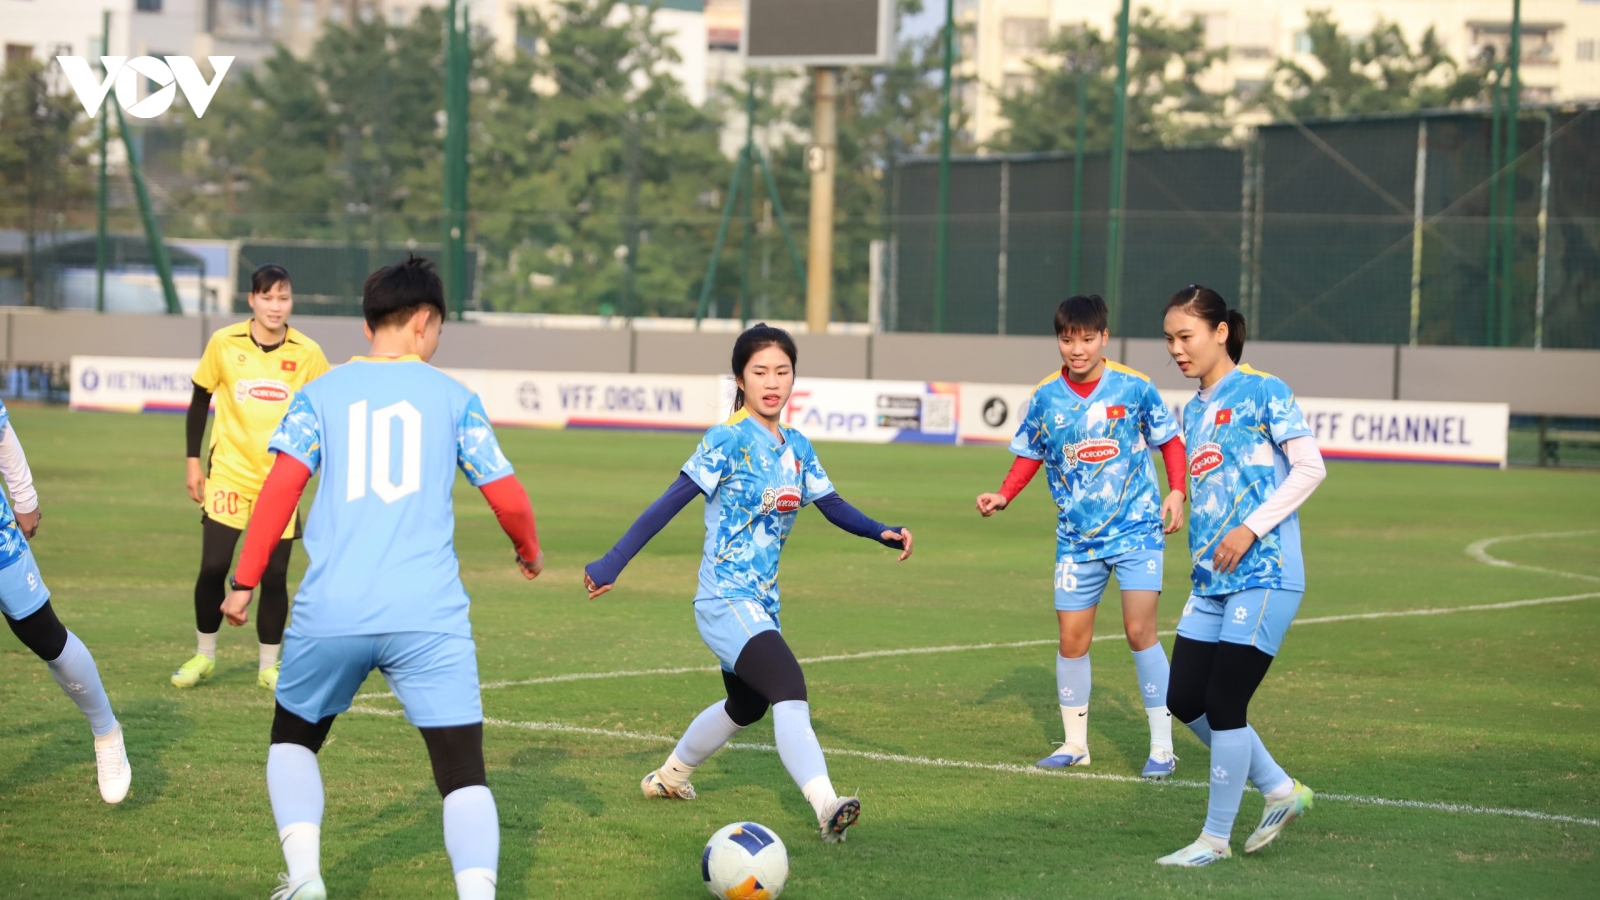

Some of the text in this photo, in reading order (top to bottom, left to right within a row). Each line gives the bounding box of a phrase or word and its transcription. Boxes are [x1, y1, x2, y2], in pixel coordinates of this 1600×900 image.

[558, 384, 682, 412] VFF.ORG.VN
[1304, 412, 1471, 445] FF CHANNEL
[346, 398, 422, 504] 10
[1075, 441, 1088, 450] Cook
[1079, 448, 1116, 459] ACECOOK
[213, 490, 239, 515] 20
[1054, 562, 1079, 593] 26
